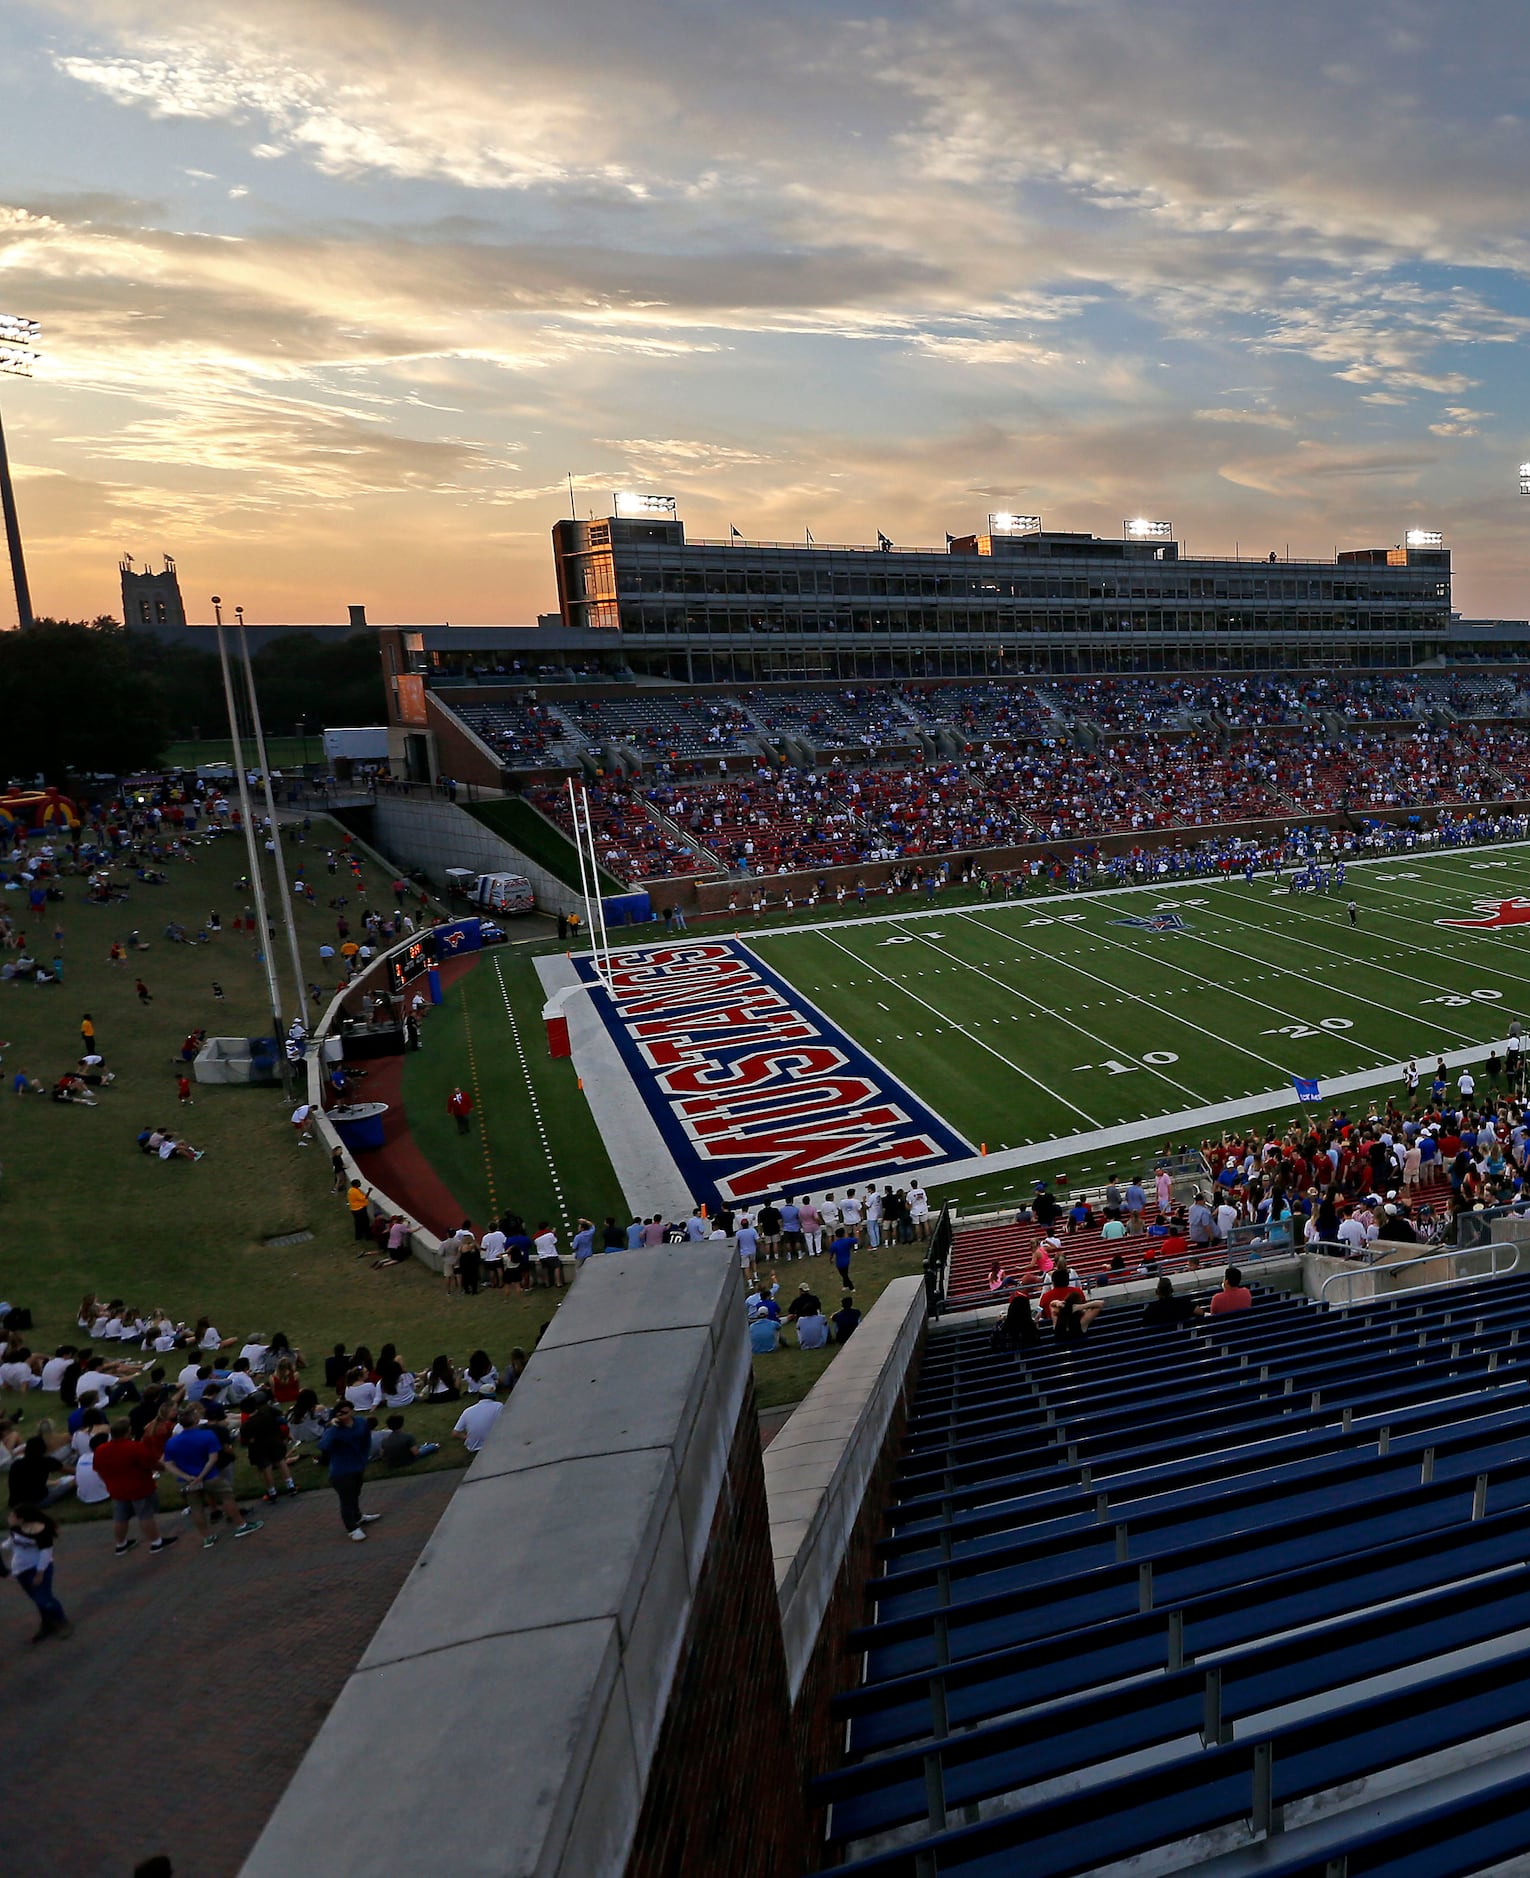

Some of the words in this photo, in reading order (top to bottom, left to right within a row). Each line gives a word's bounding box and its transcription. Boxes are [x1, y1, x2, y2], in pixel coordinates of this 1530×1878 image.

[1156, 898, 1211, 910] 30
[1029, 913, 1087, 926] 20
[886, 931, 946, 944] 10
[1433, 988, 1504, 1007] 30
[1278, 1017, 1354, 1039] 20
[1097, 1050, 1180, 1076] 10
[589, 944, 948, 1203] MUSTANGS
[670, 1234, 683, 1244] 10
